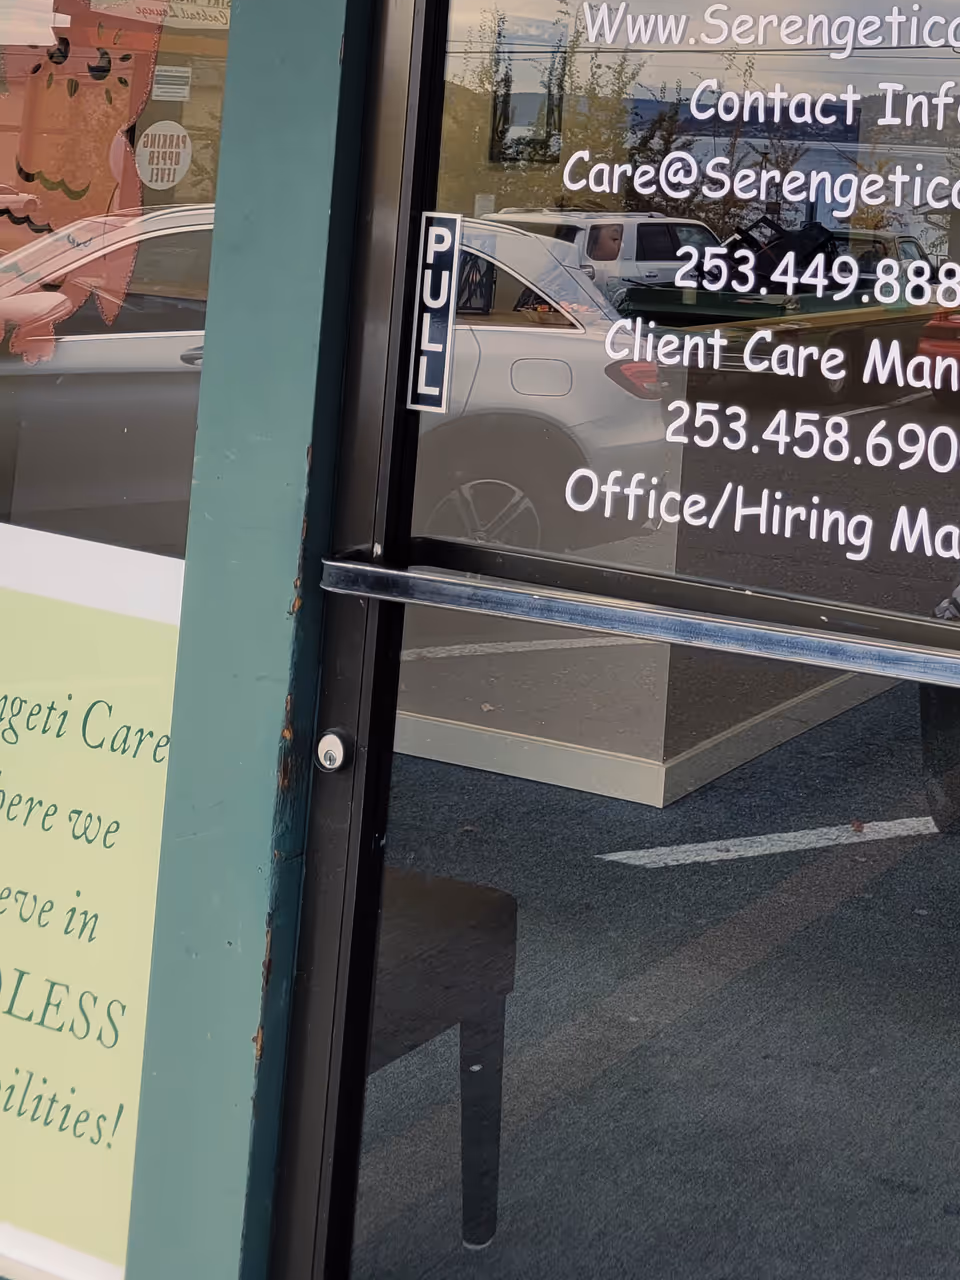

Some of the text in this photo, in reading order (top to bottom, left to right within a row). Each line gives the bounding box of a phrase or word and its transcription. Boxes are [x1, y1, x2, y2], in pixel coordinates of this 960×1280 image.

[689, 78, 862, 126] Contact
[417, 226, 451, 396] PULL
[604, 317, 728, 370] Client
[743, 329, 847, 381] Care
[564, 468, 874, 562] Office/Hiring
[82, 699, 171, 763] Care
[68, 809, 121, 849] we
[64, 889, 99, 943] in
[0, 967, 127, 1049] LESS
[0, 1066, 124, 1149] ilities!
